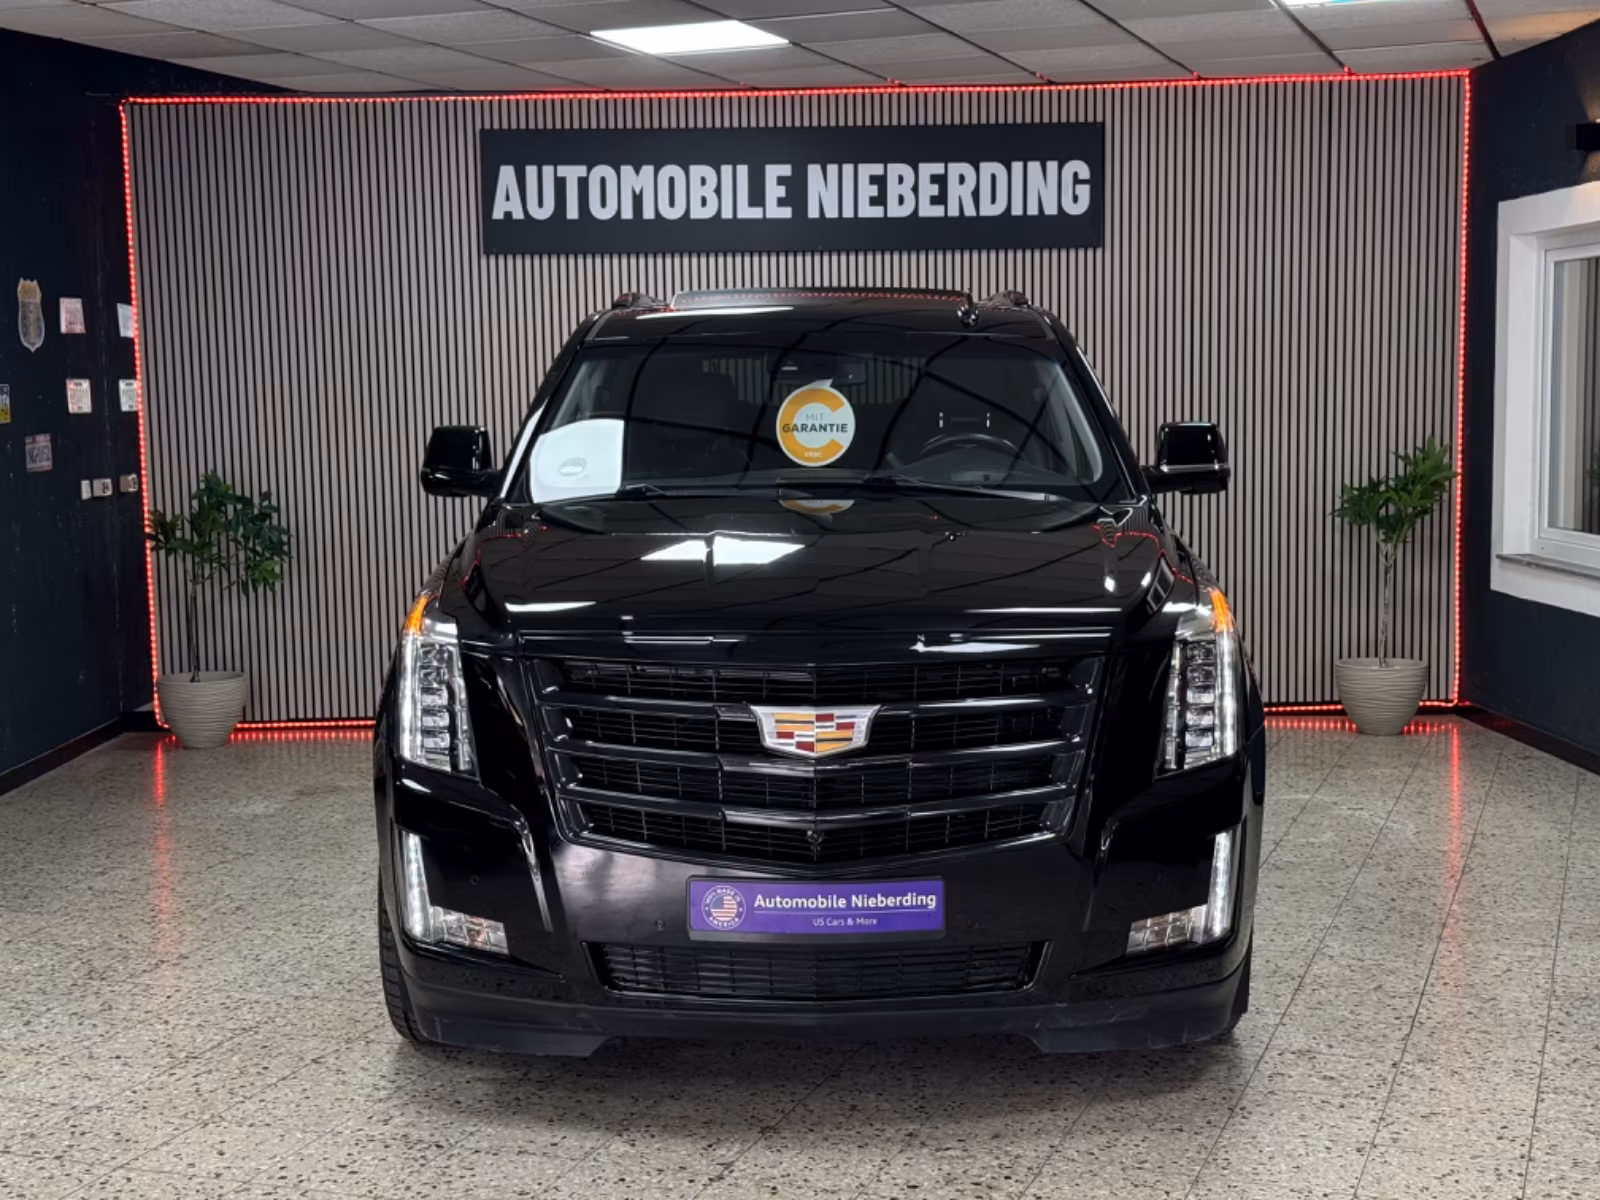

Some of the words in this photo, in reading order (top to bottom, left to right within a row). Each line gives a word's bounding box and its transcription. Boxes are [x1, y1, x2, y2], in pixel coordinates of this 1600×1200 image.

[491, 163, 793, 220] AUTOMOBILE
[806, 160, 1092, 218] NIEBERDING
[805, 413, 825, 421] MIT
[782, 423, 849, 433] GARANTIE
[754, 894, 847, 909] Automobile
[851, 892, 937, 909] Nieberding
[812, 917, 825, 926] US
[826, 917, 845, 926] Cars
[847, 917, 854, 926] &
[856, 917, 878, 926] More
